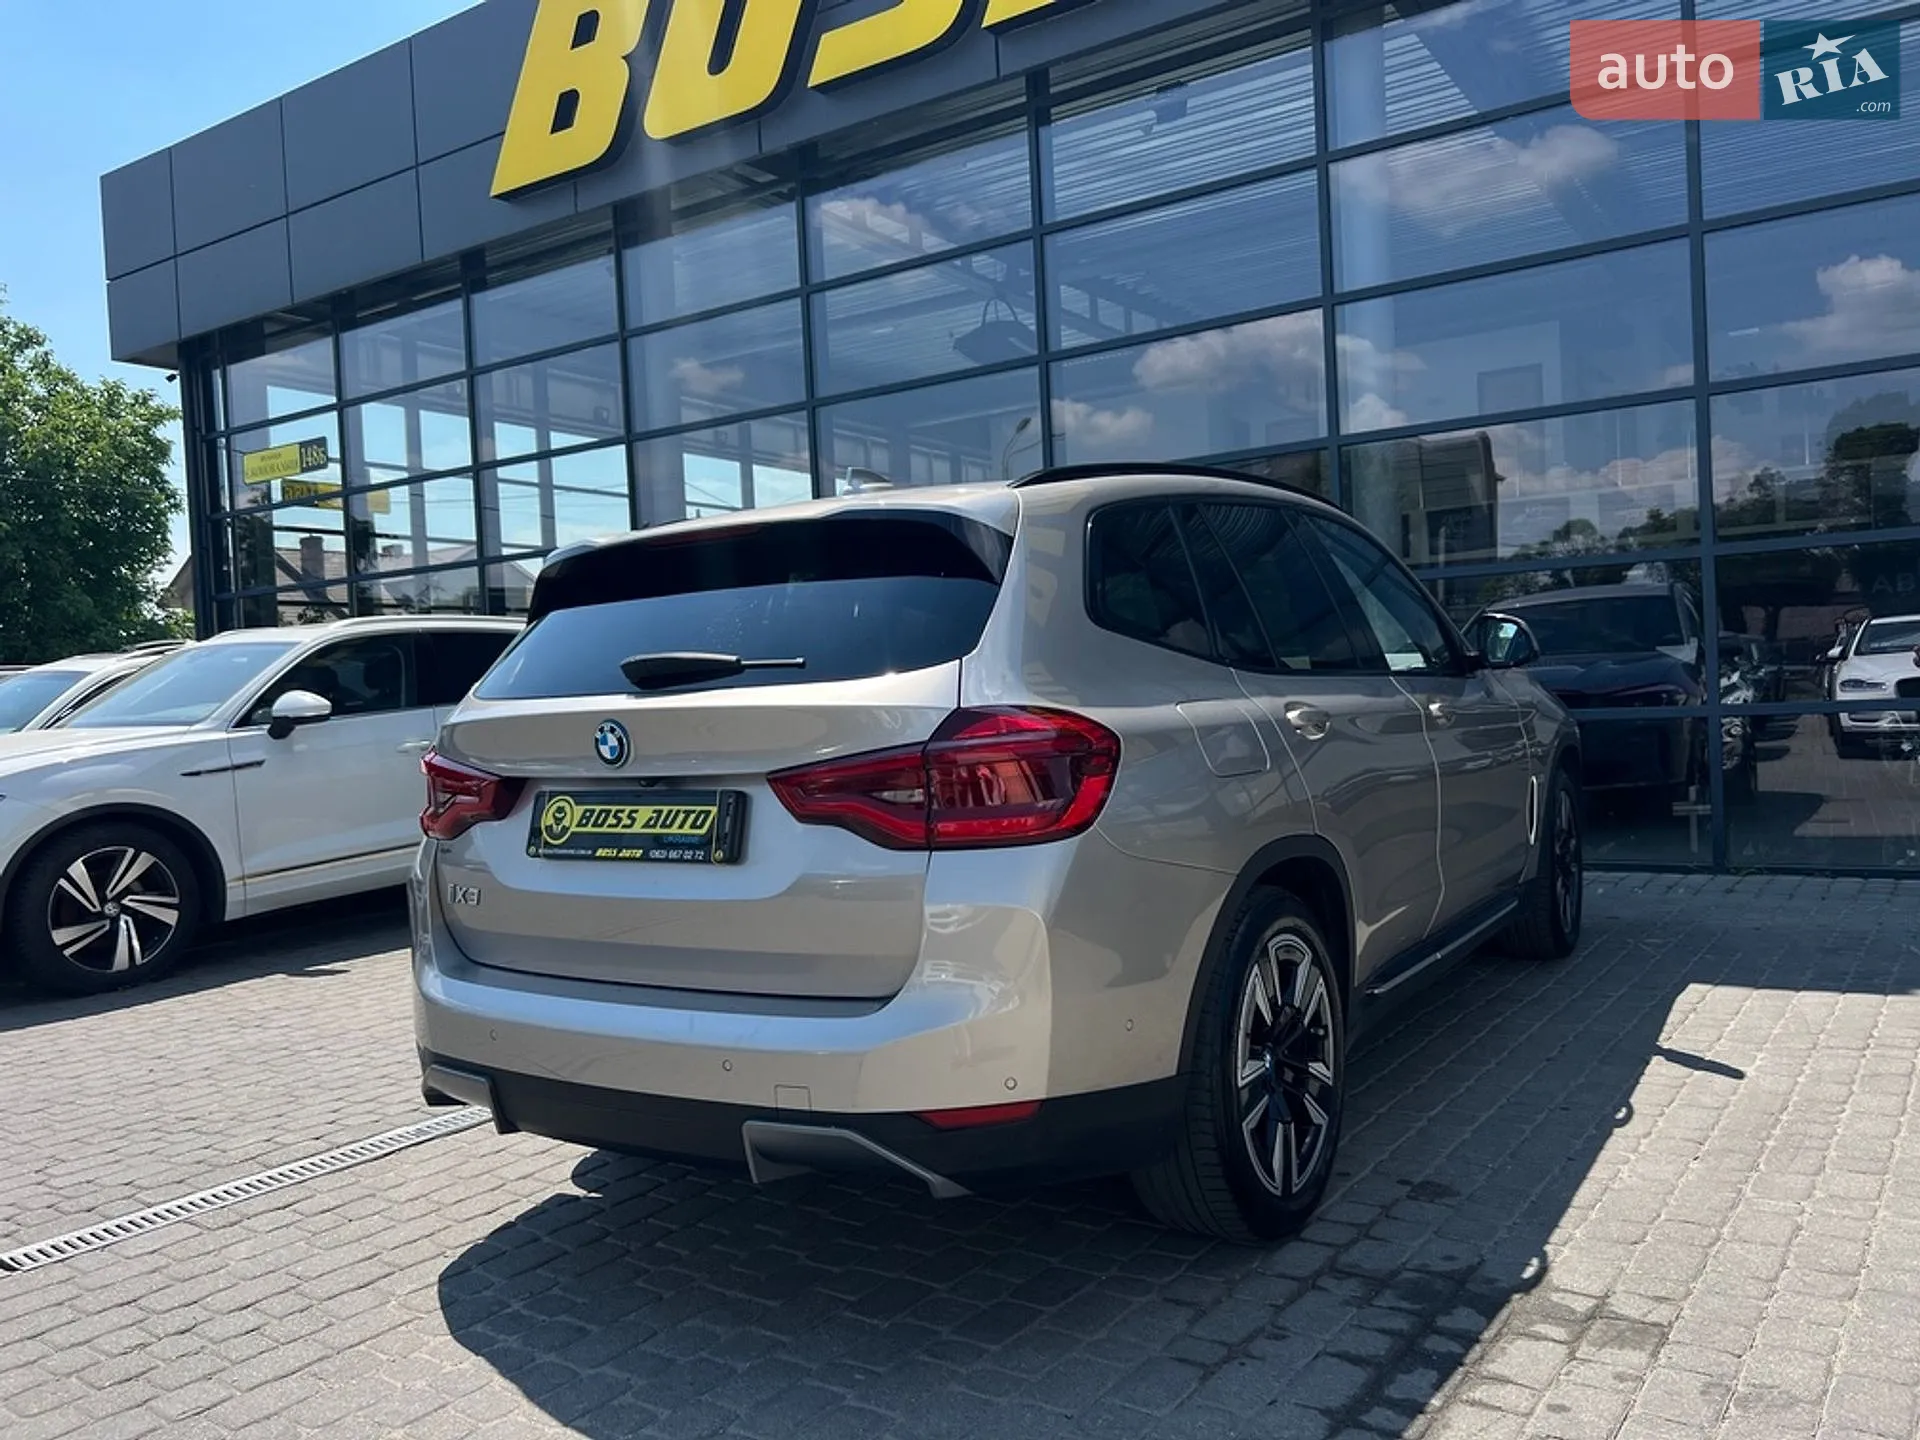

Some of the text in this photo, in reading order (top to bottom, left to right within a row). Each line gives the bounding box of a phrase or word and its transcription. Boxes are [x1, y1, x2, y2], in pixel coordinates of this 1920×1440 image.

[489, 0, 1058, 197] BO
[576, 808, 714, 830] BOSS AUTO
[595, 848, 618, 857] BOSS
[618, 848, 643, 858] AUTO
